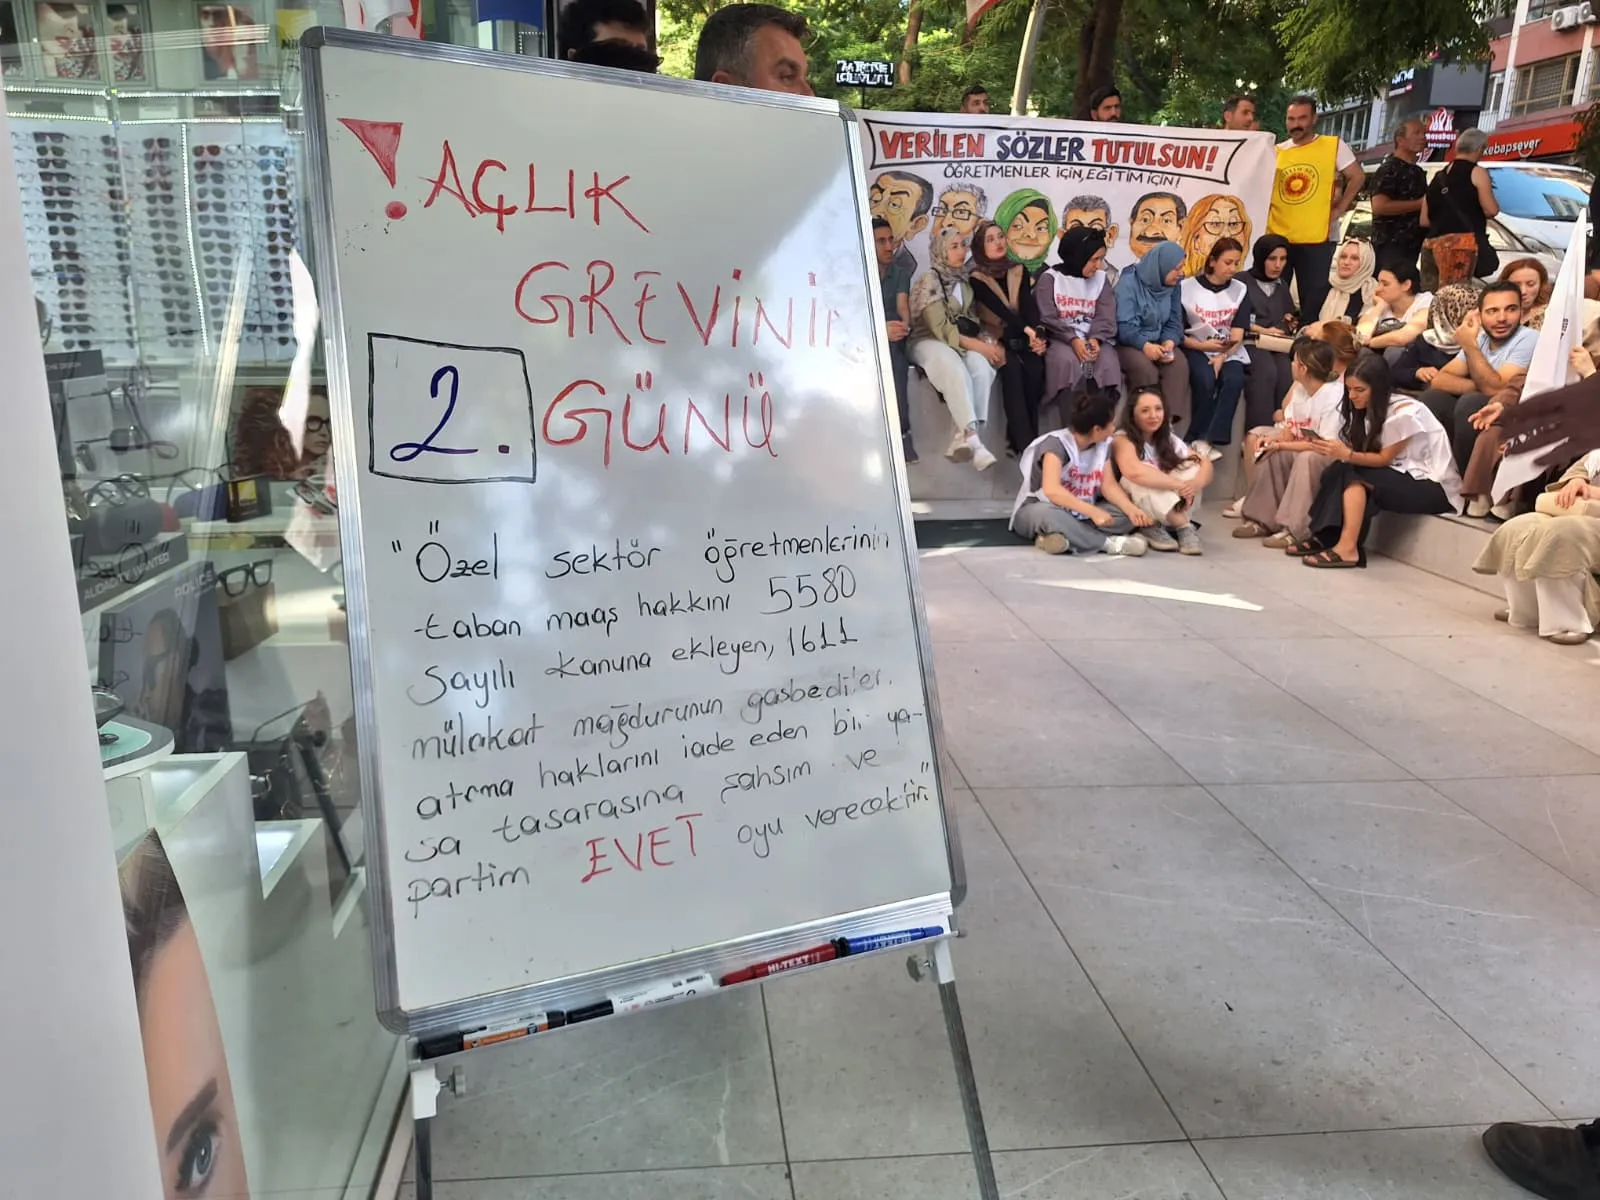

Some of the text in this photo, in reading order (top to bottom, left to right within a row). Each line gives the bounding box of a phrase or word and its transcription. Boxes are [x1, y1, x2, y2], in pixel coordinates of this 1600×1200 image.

[417, 139, 651, 233] AÇLIK
[879, 128, 1220, 172] VERİLEN SÖZLER TUTULSUN!
[943, 161, 1051, 179] ÖĞRETMENLER
[390, 365, 779, 468] 2. GÜNÜ
[413, 563, 857, 640] taban maaş hakkını 5580
[787, 616, 858, 657] 1611
[538, 748, 659, 789] haklarını
[682, 731, 736, 758] iade
[749, 719, 809, 746] eden
[404, 835, 461, 863] sa
[844, 748, 882, 771] ve
[407, 861, 530, 919] partim
[580, 812, 703, 884] EVET
[737, 817, 784, 859] oyu
[767, 953, 811, 973] HI-TEXT
